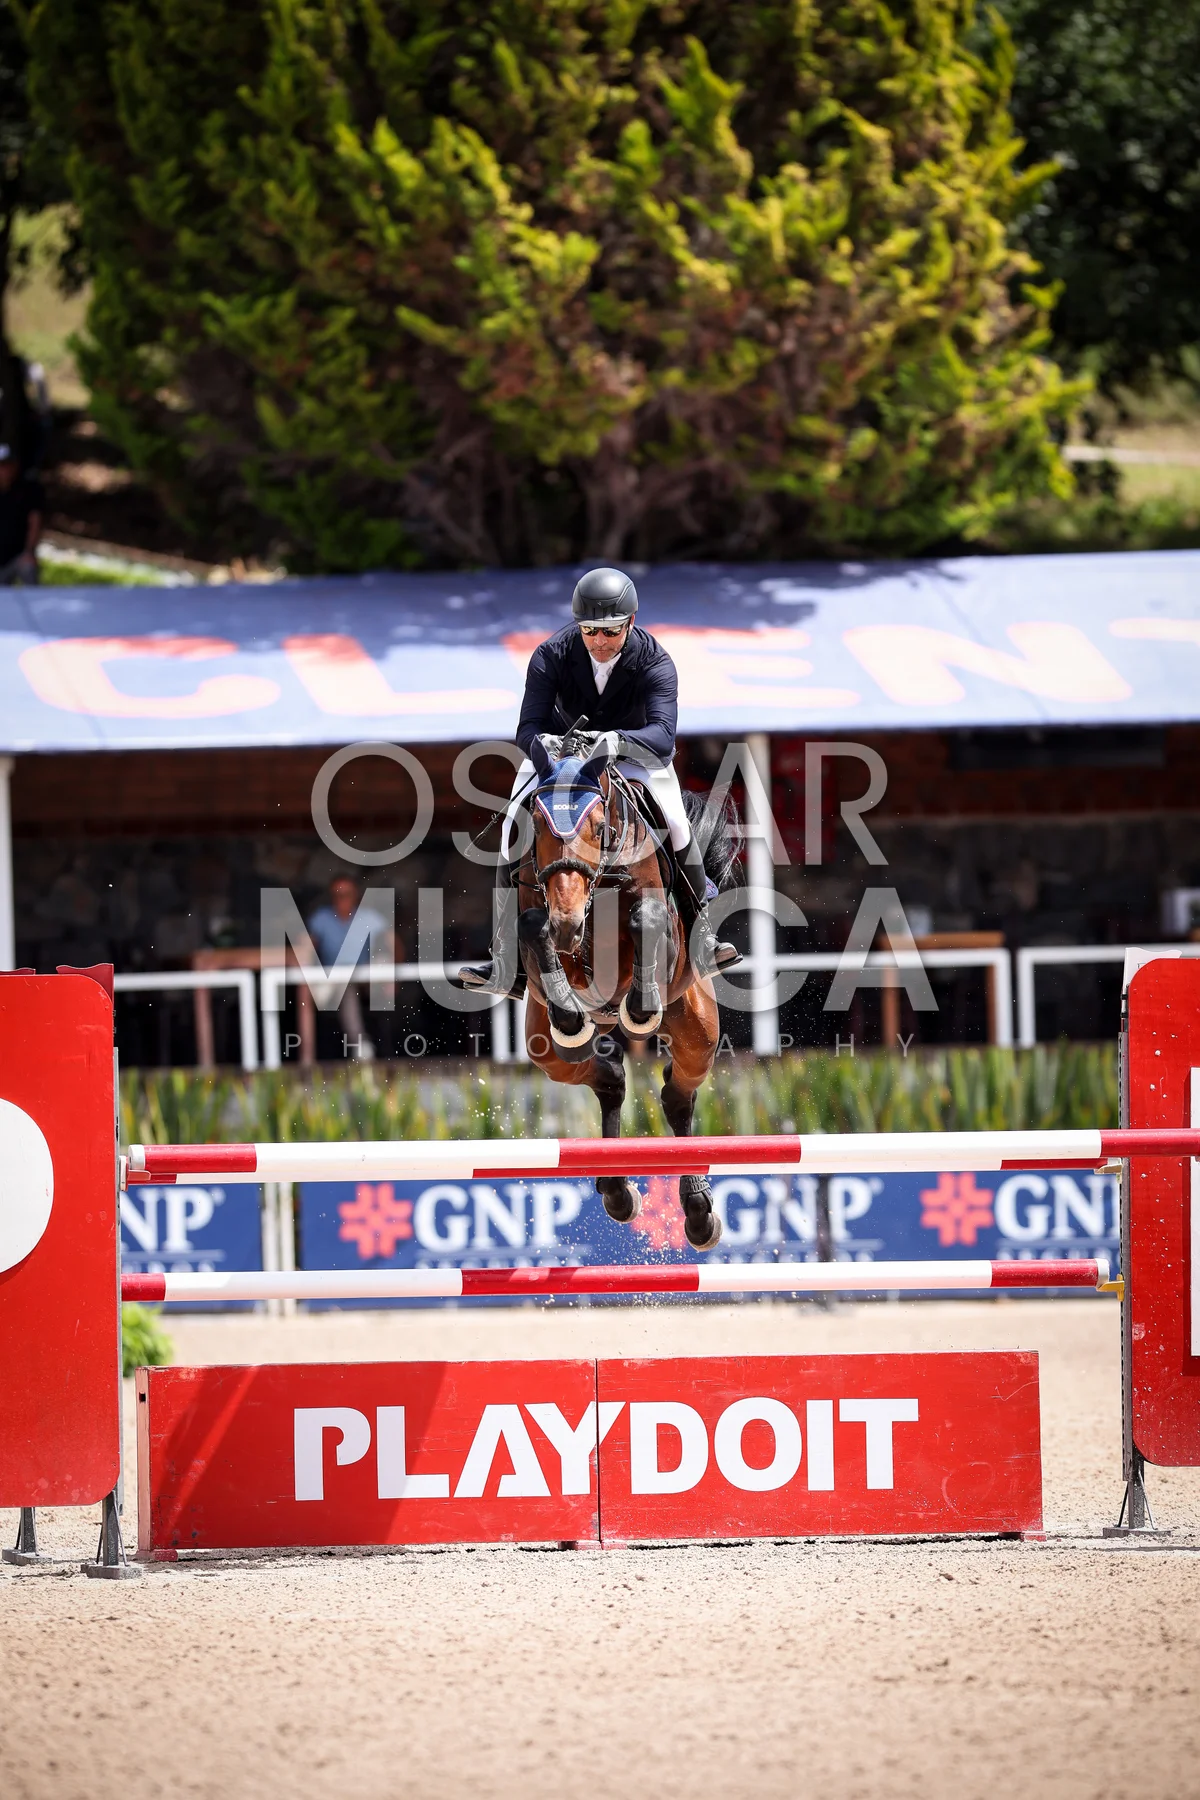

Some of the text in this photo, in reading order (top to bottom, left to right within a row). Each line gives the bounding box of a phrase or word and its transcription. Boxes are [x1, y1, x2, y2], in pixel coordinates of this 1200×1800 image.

[18, 617, 1200, 718] CLEN
[120, 1186, 214, 1253] NP
[413, 1183, 582, 1252] GNP
[712, 1176, 872, 1245] GNP
[994, 1174, 1120, 1241] GN
[294, 1396, 918, 1501] PLAYDOIT
